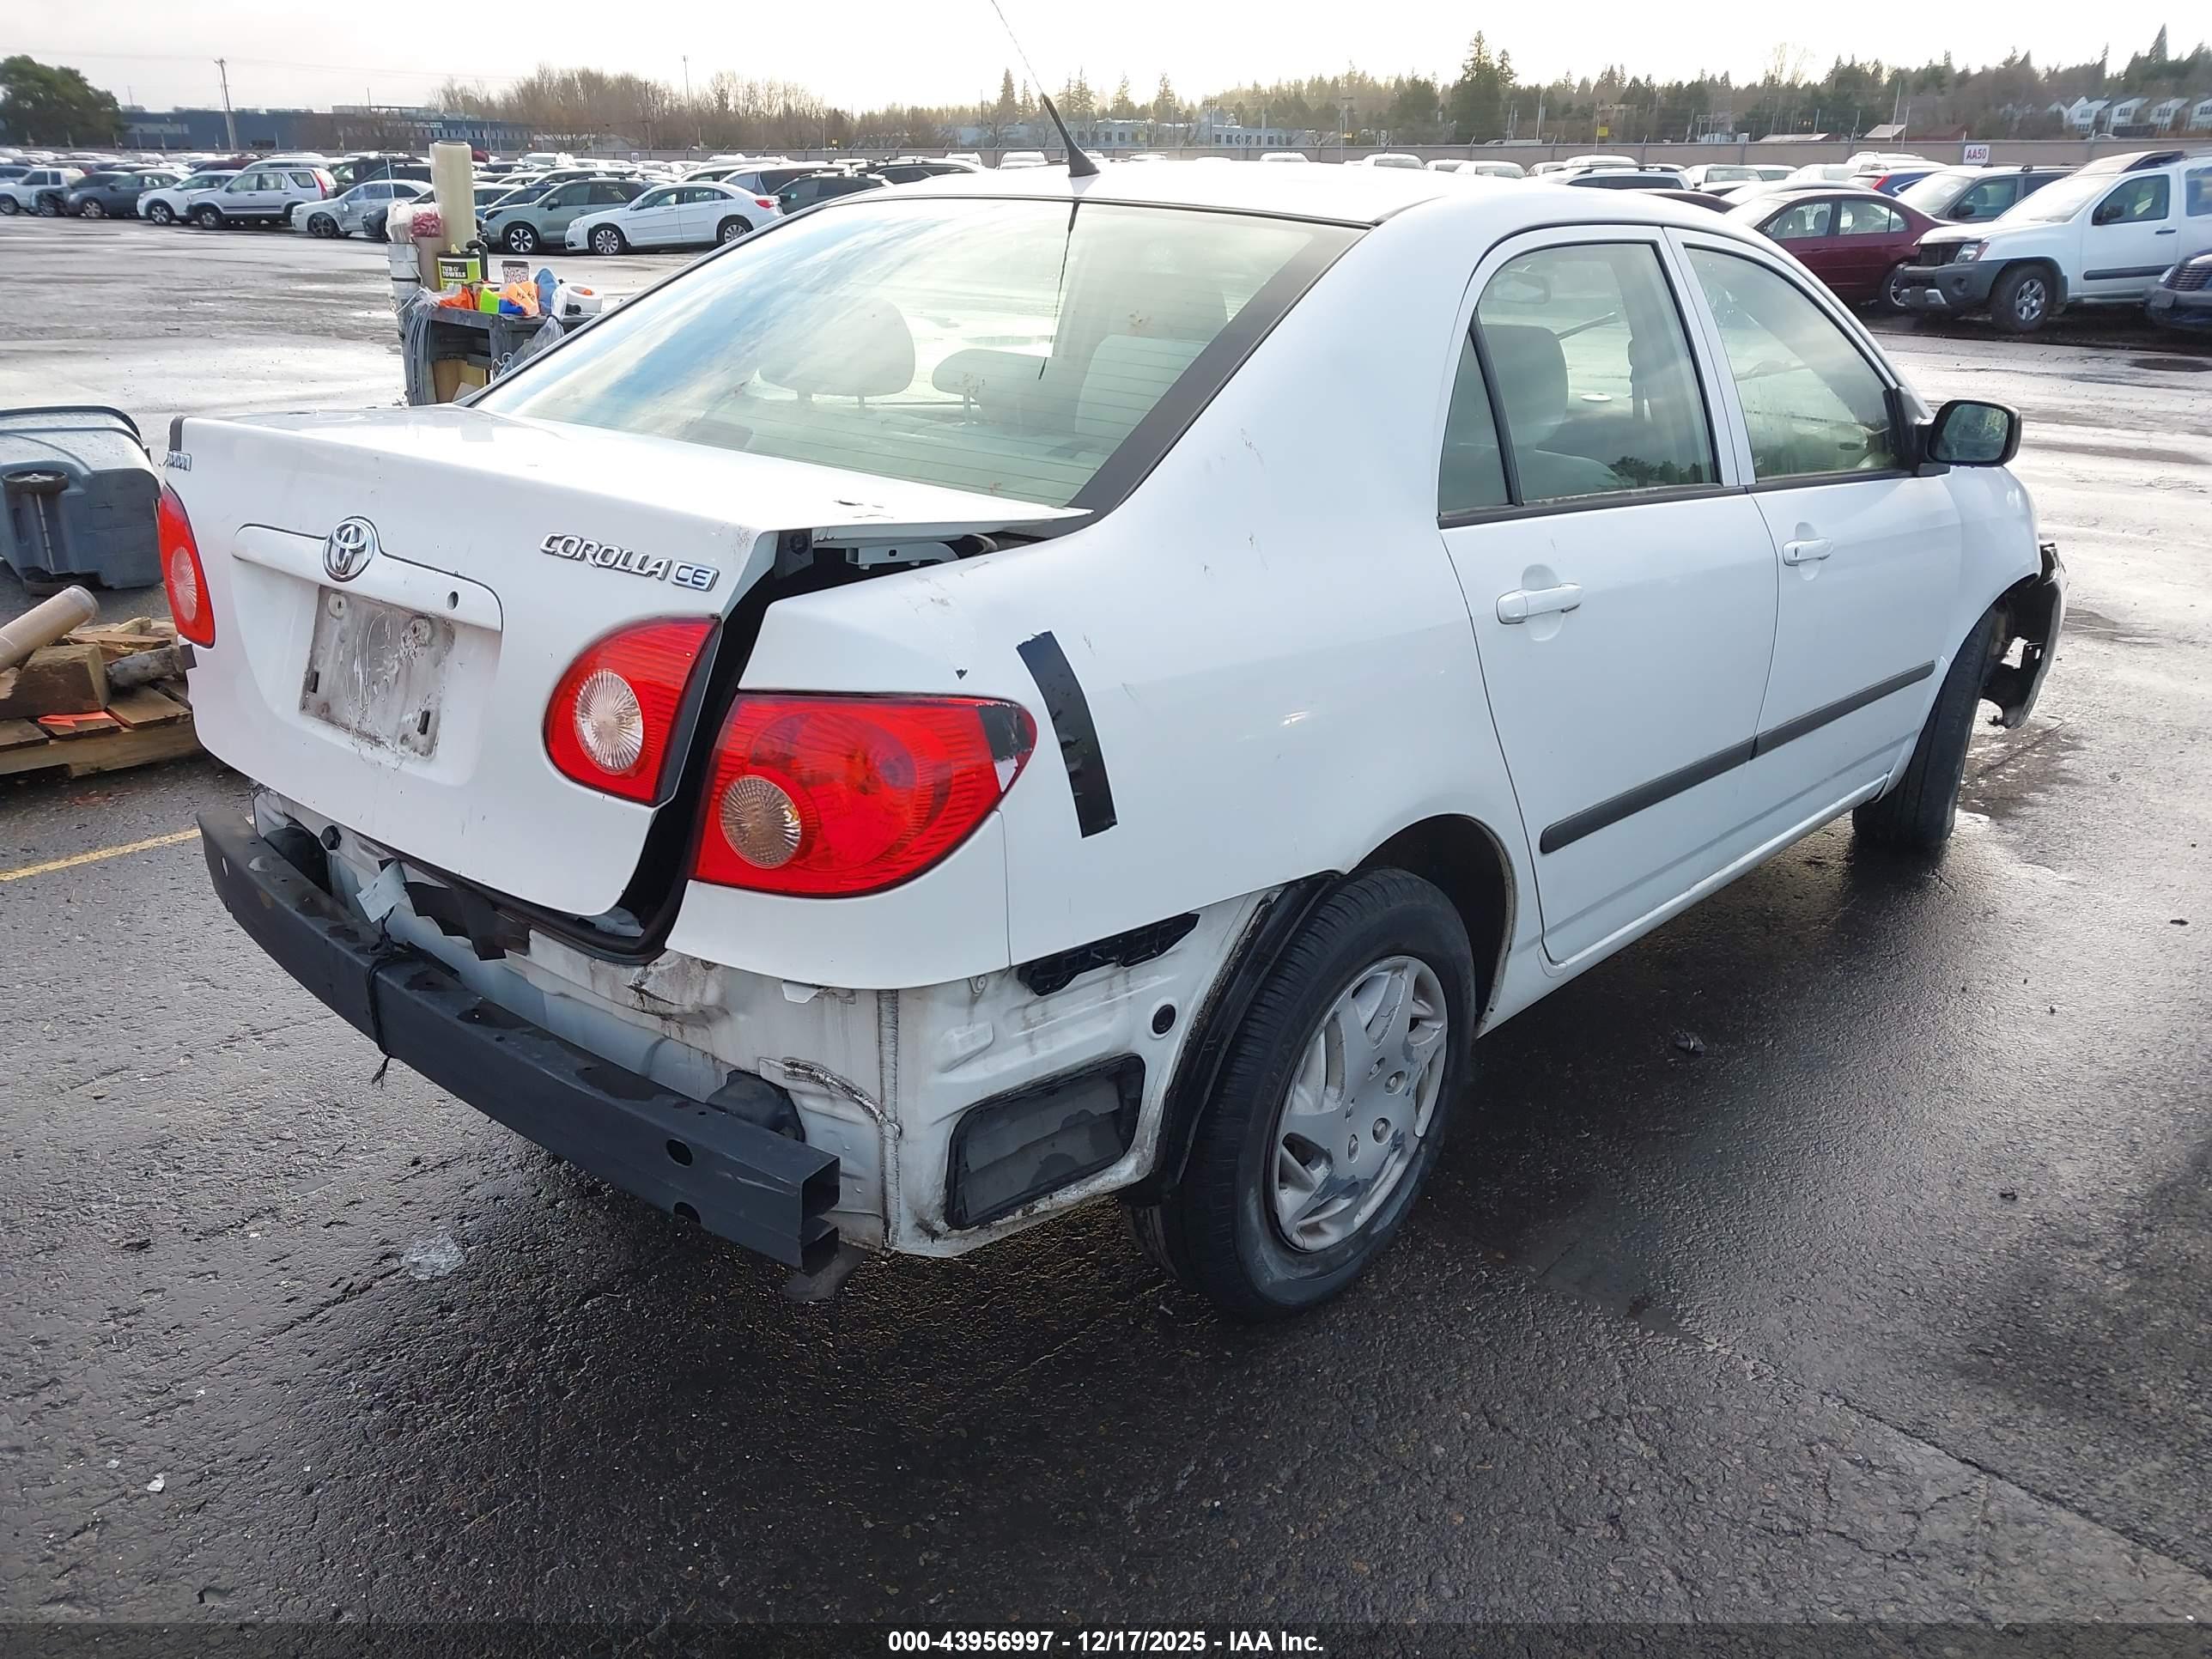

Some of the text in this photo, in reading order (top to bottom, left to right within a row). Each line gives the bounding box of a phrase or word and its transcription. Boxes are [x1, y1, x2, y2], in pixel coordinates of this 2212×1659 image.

[1966, 148, 1987, 160] AA50
[539, 532, 714, 588] COROLLA CE
